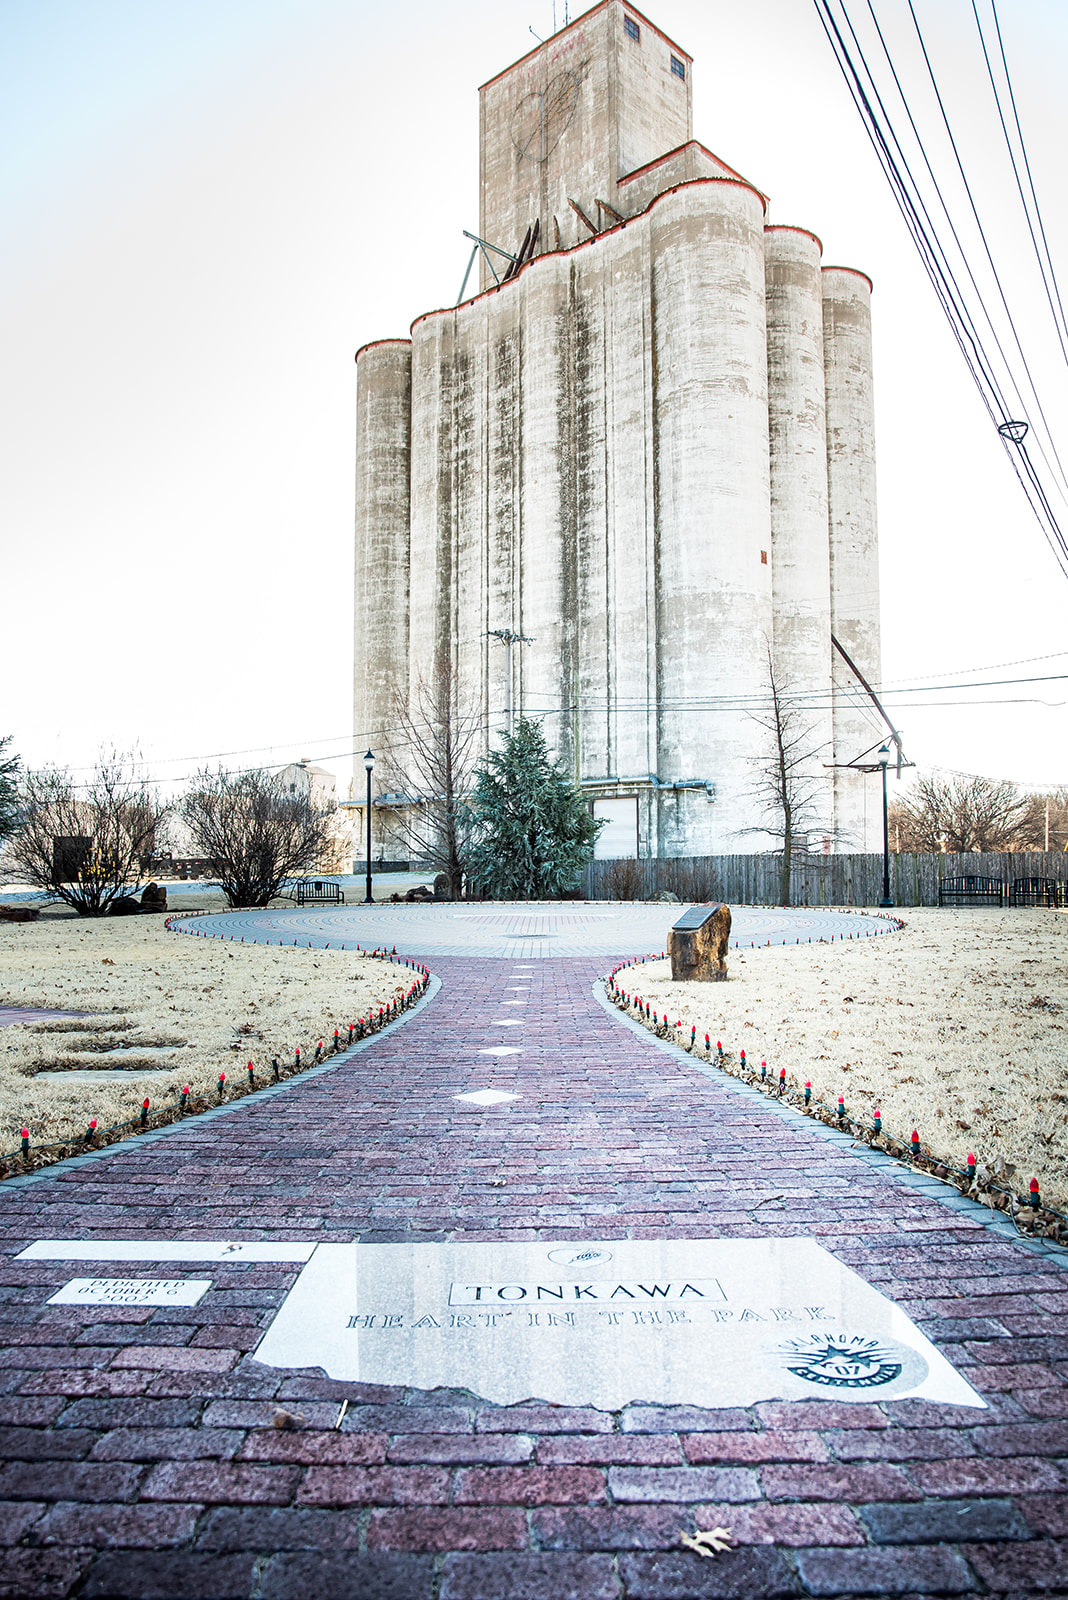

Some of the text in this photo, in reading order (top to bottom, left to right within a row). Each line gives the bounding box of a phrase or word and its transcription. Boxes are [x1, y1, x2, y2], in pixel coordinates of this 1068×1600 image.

[90, 1280, 186, 1288] DEDICATED
[77, 1287, 158, 1296] OCTOBER
[465, 1283, 705, 1301] TONKAWA
[97, 1295, 150, 1304] 2007
[346, 1306, 836, 1329] HEART IN THE PARK
[795, 1366, 897, 1387] CENTENNIAL
